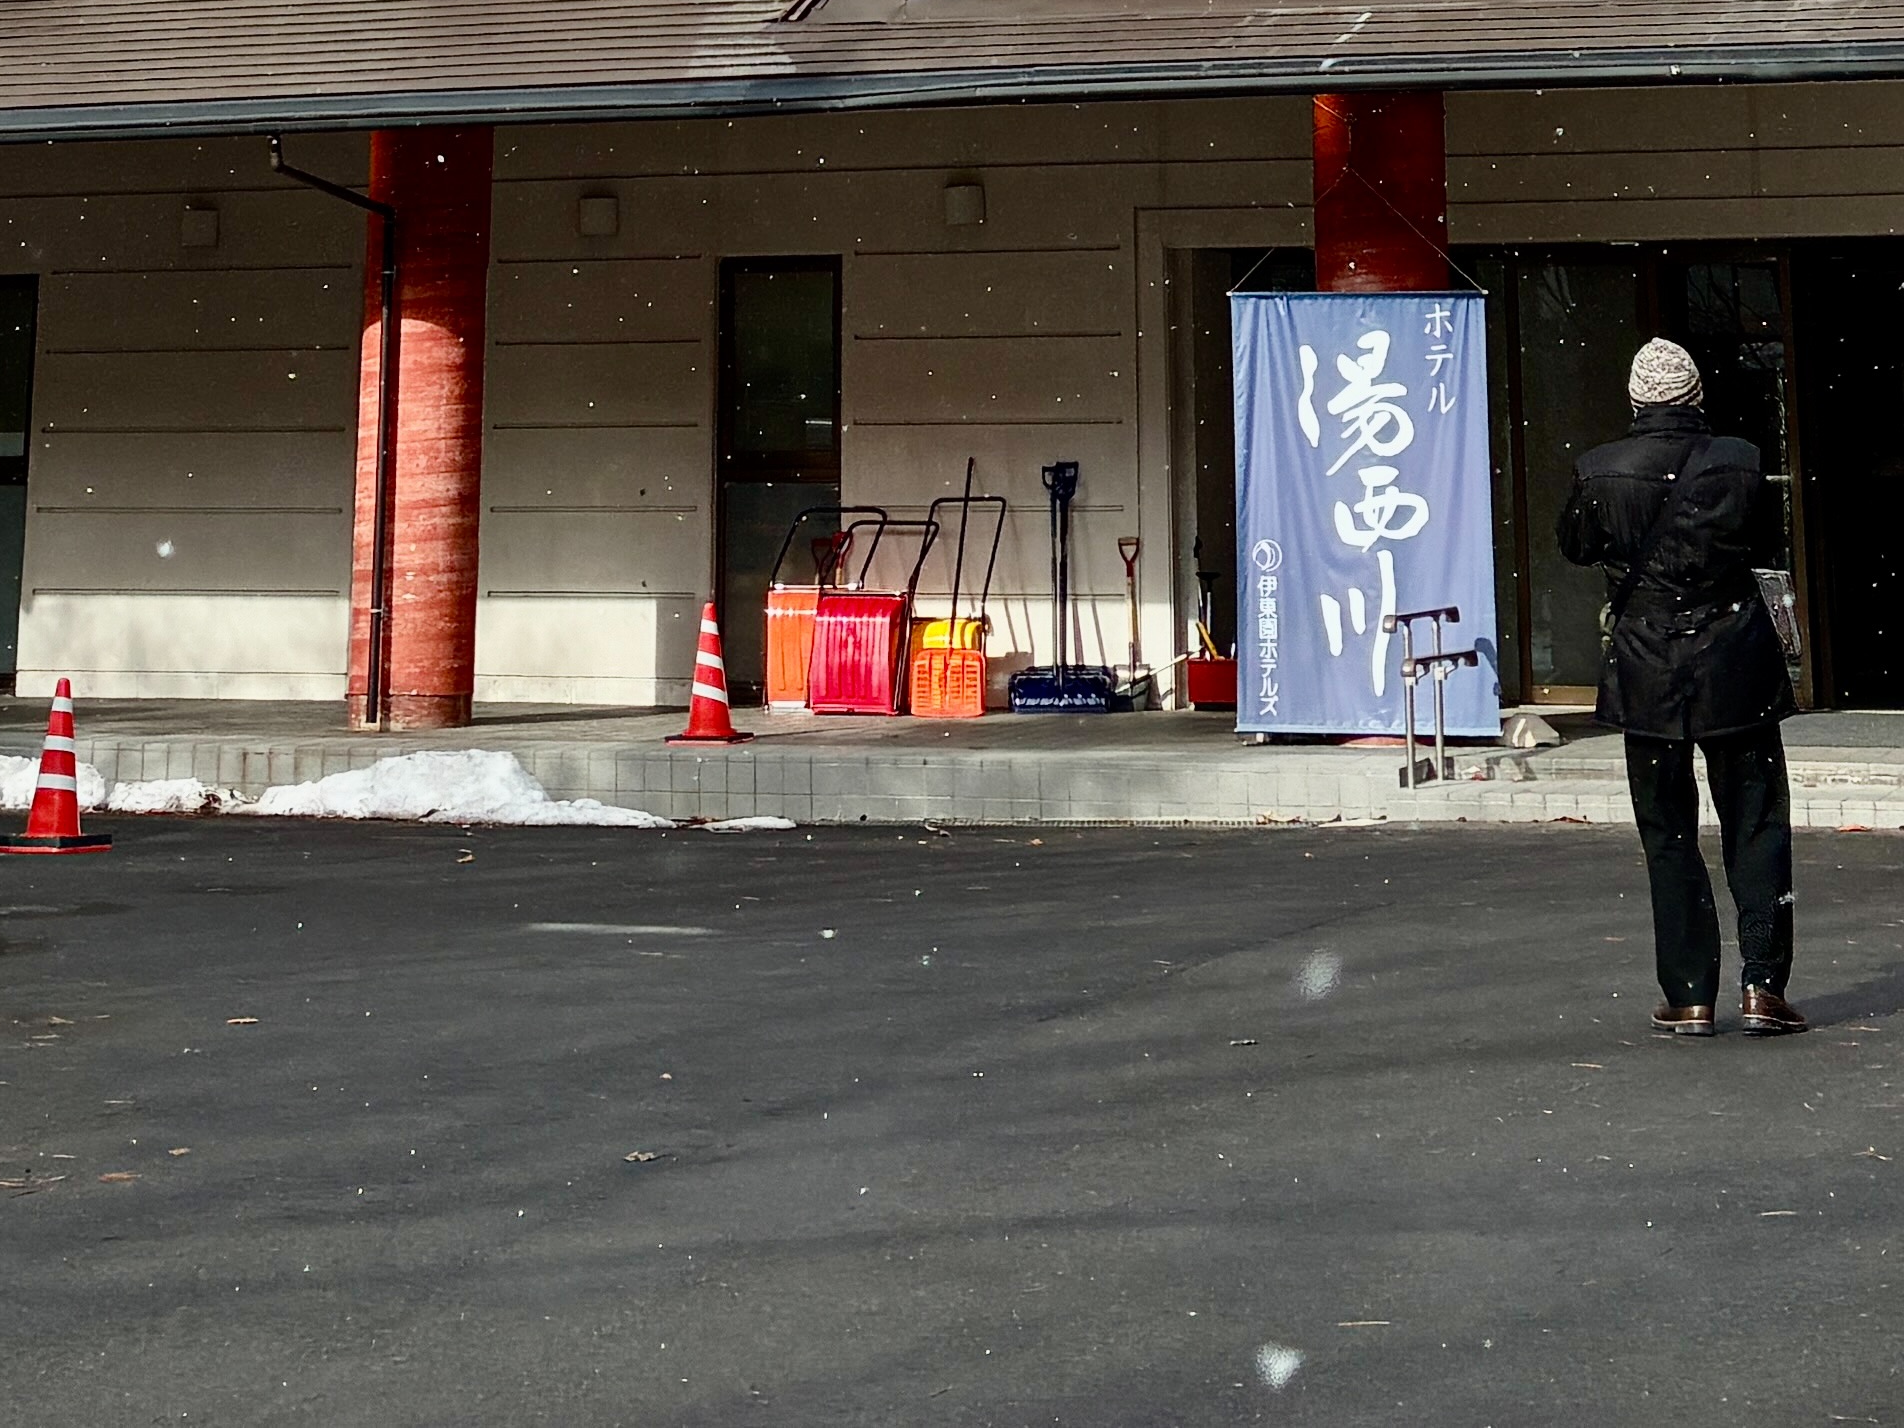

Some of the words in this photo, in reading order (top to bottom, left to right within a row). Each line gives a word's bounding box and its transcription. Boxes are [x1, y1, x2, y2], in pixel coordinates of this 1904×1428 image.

[1423, 302, 1457, 415] ホテル
[1298, 329, 1431, 698] 湯西川
[1257, 575, 1279, 717] 伊東園ホテルズ
